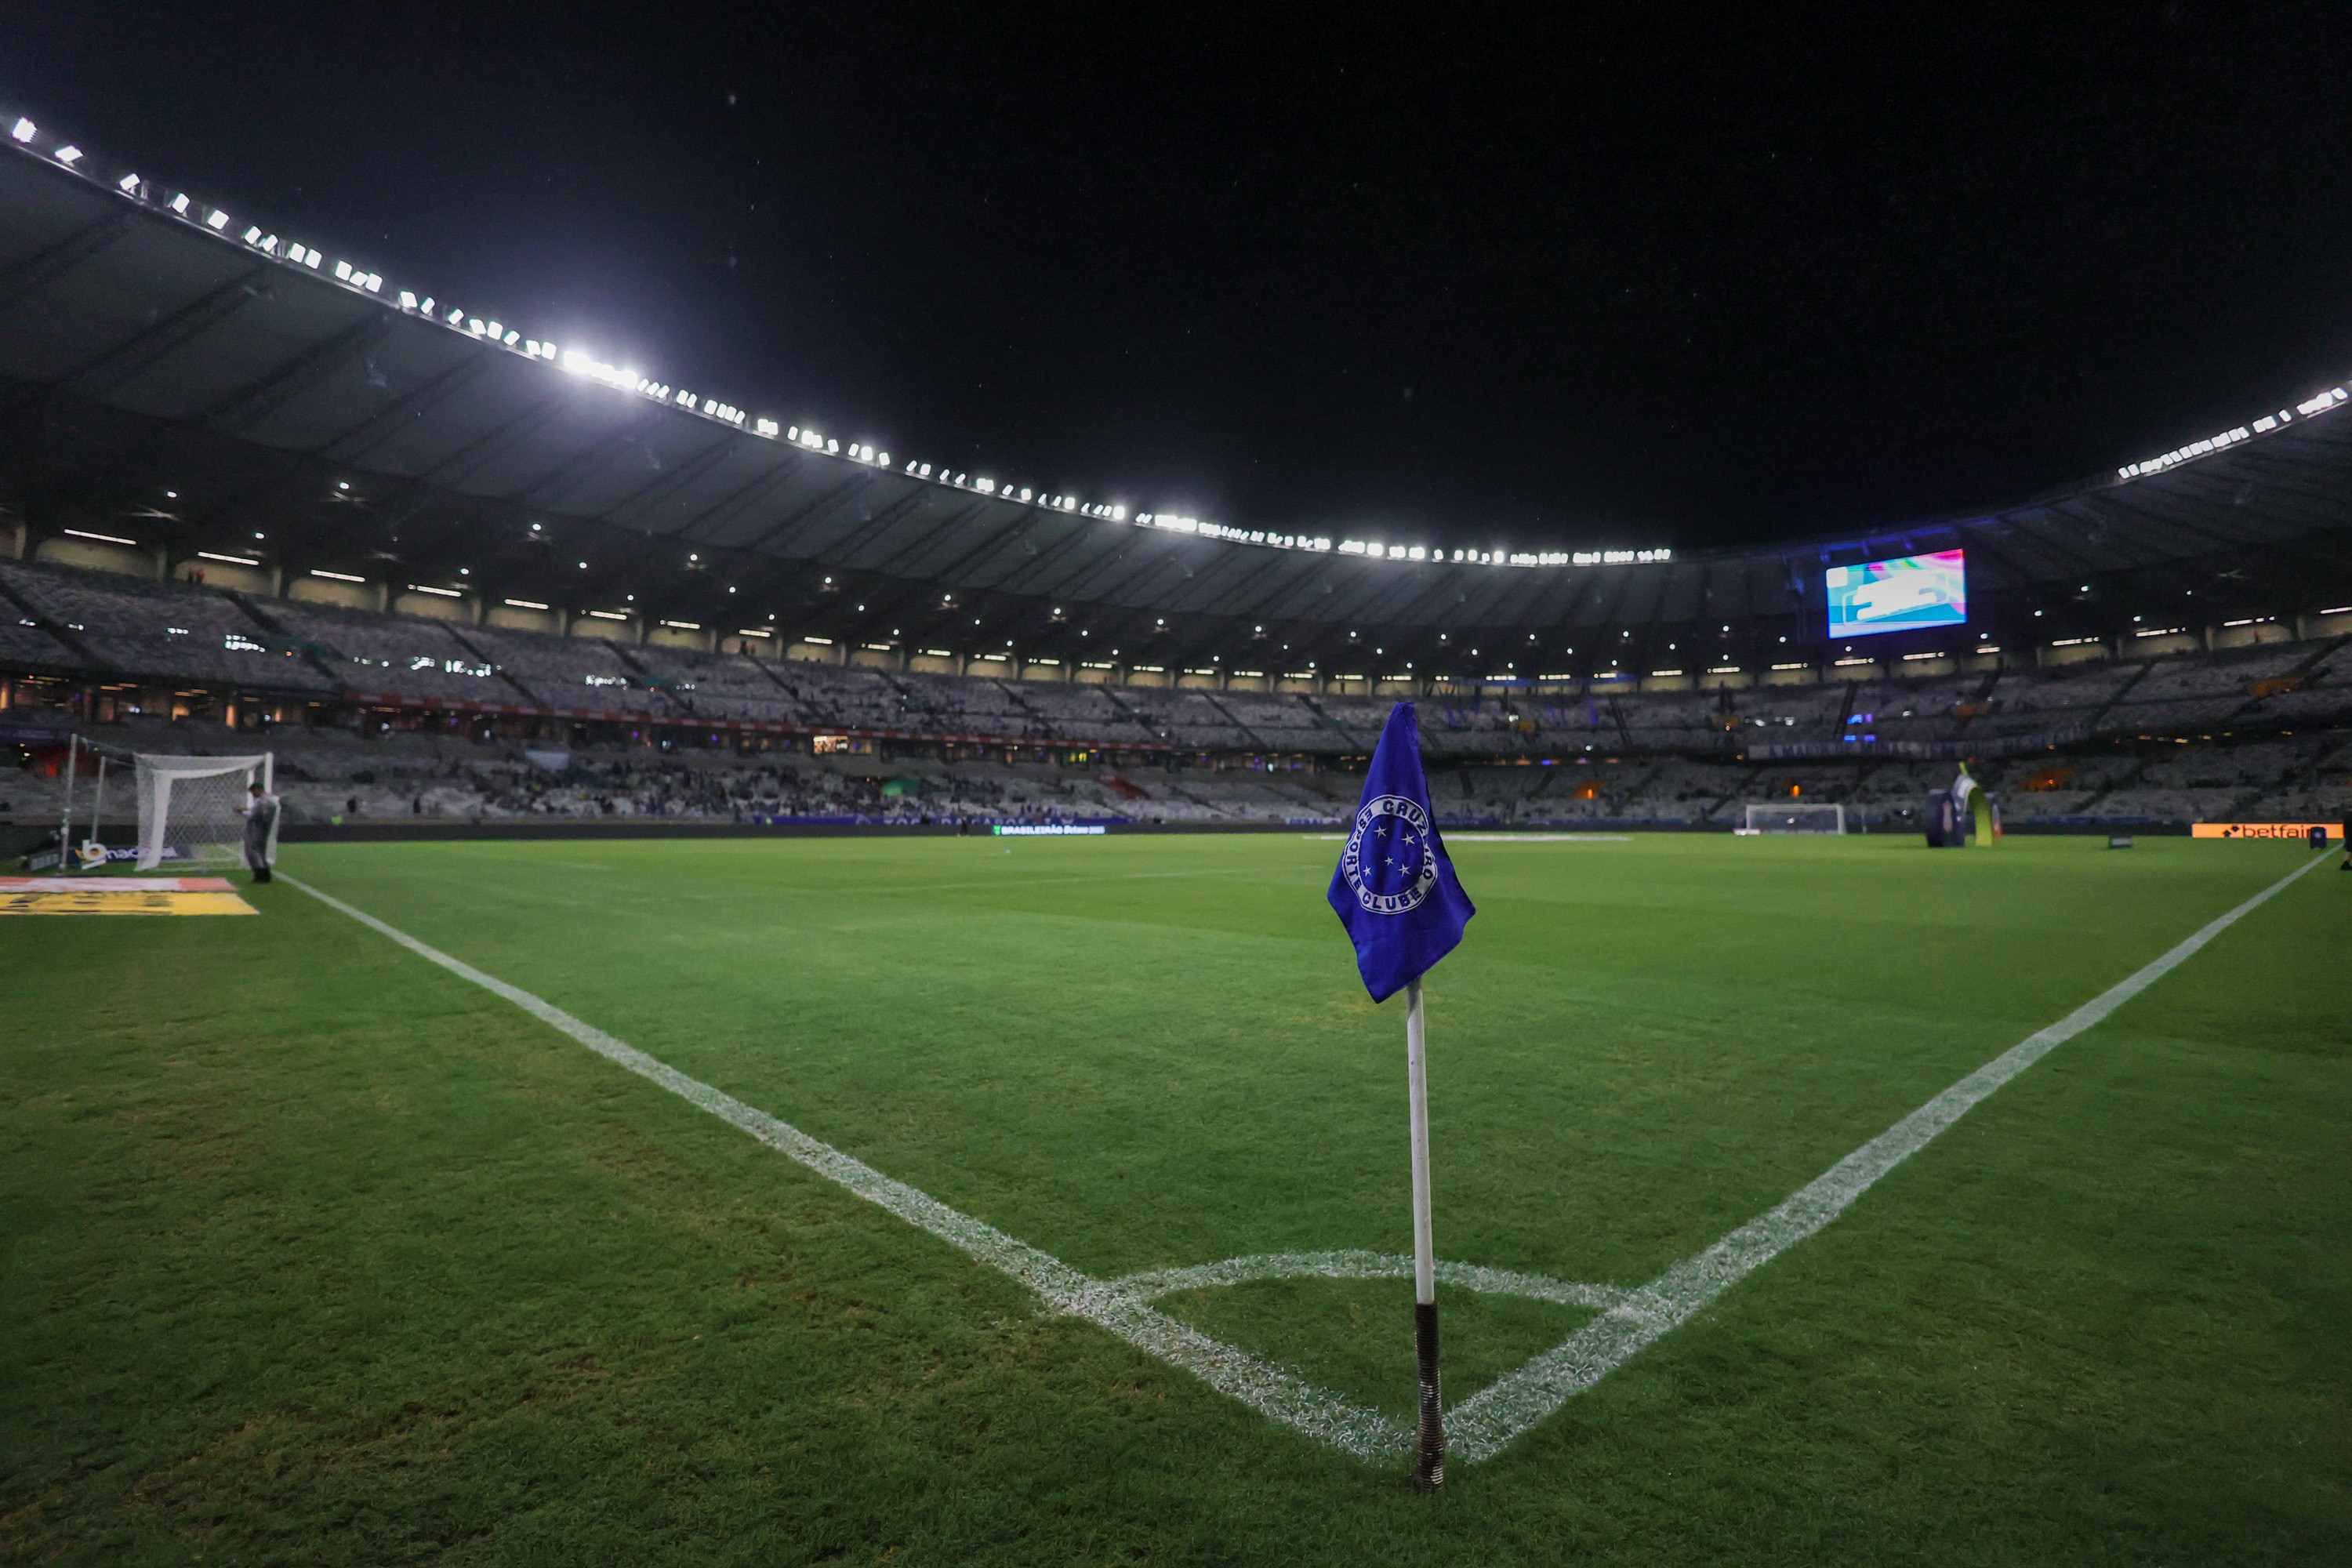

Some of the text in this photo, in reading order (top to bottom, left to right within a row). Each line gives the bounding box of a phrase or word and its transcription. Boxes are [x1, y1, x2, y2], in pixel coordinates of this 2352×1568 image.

[1001, 824, 1063, 835] BRASILEIRÃO
[2243, 825, 2311, 838] betfair
[1346, 809, 1374, 890] ESPORTE
[1362, 887, 1422, 910] CLUBE
